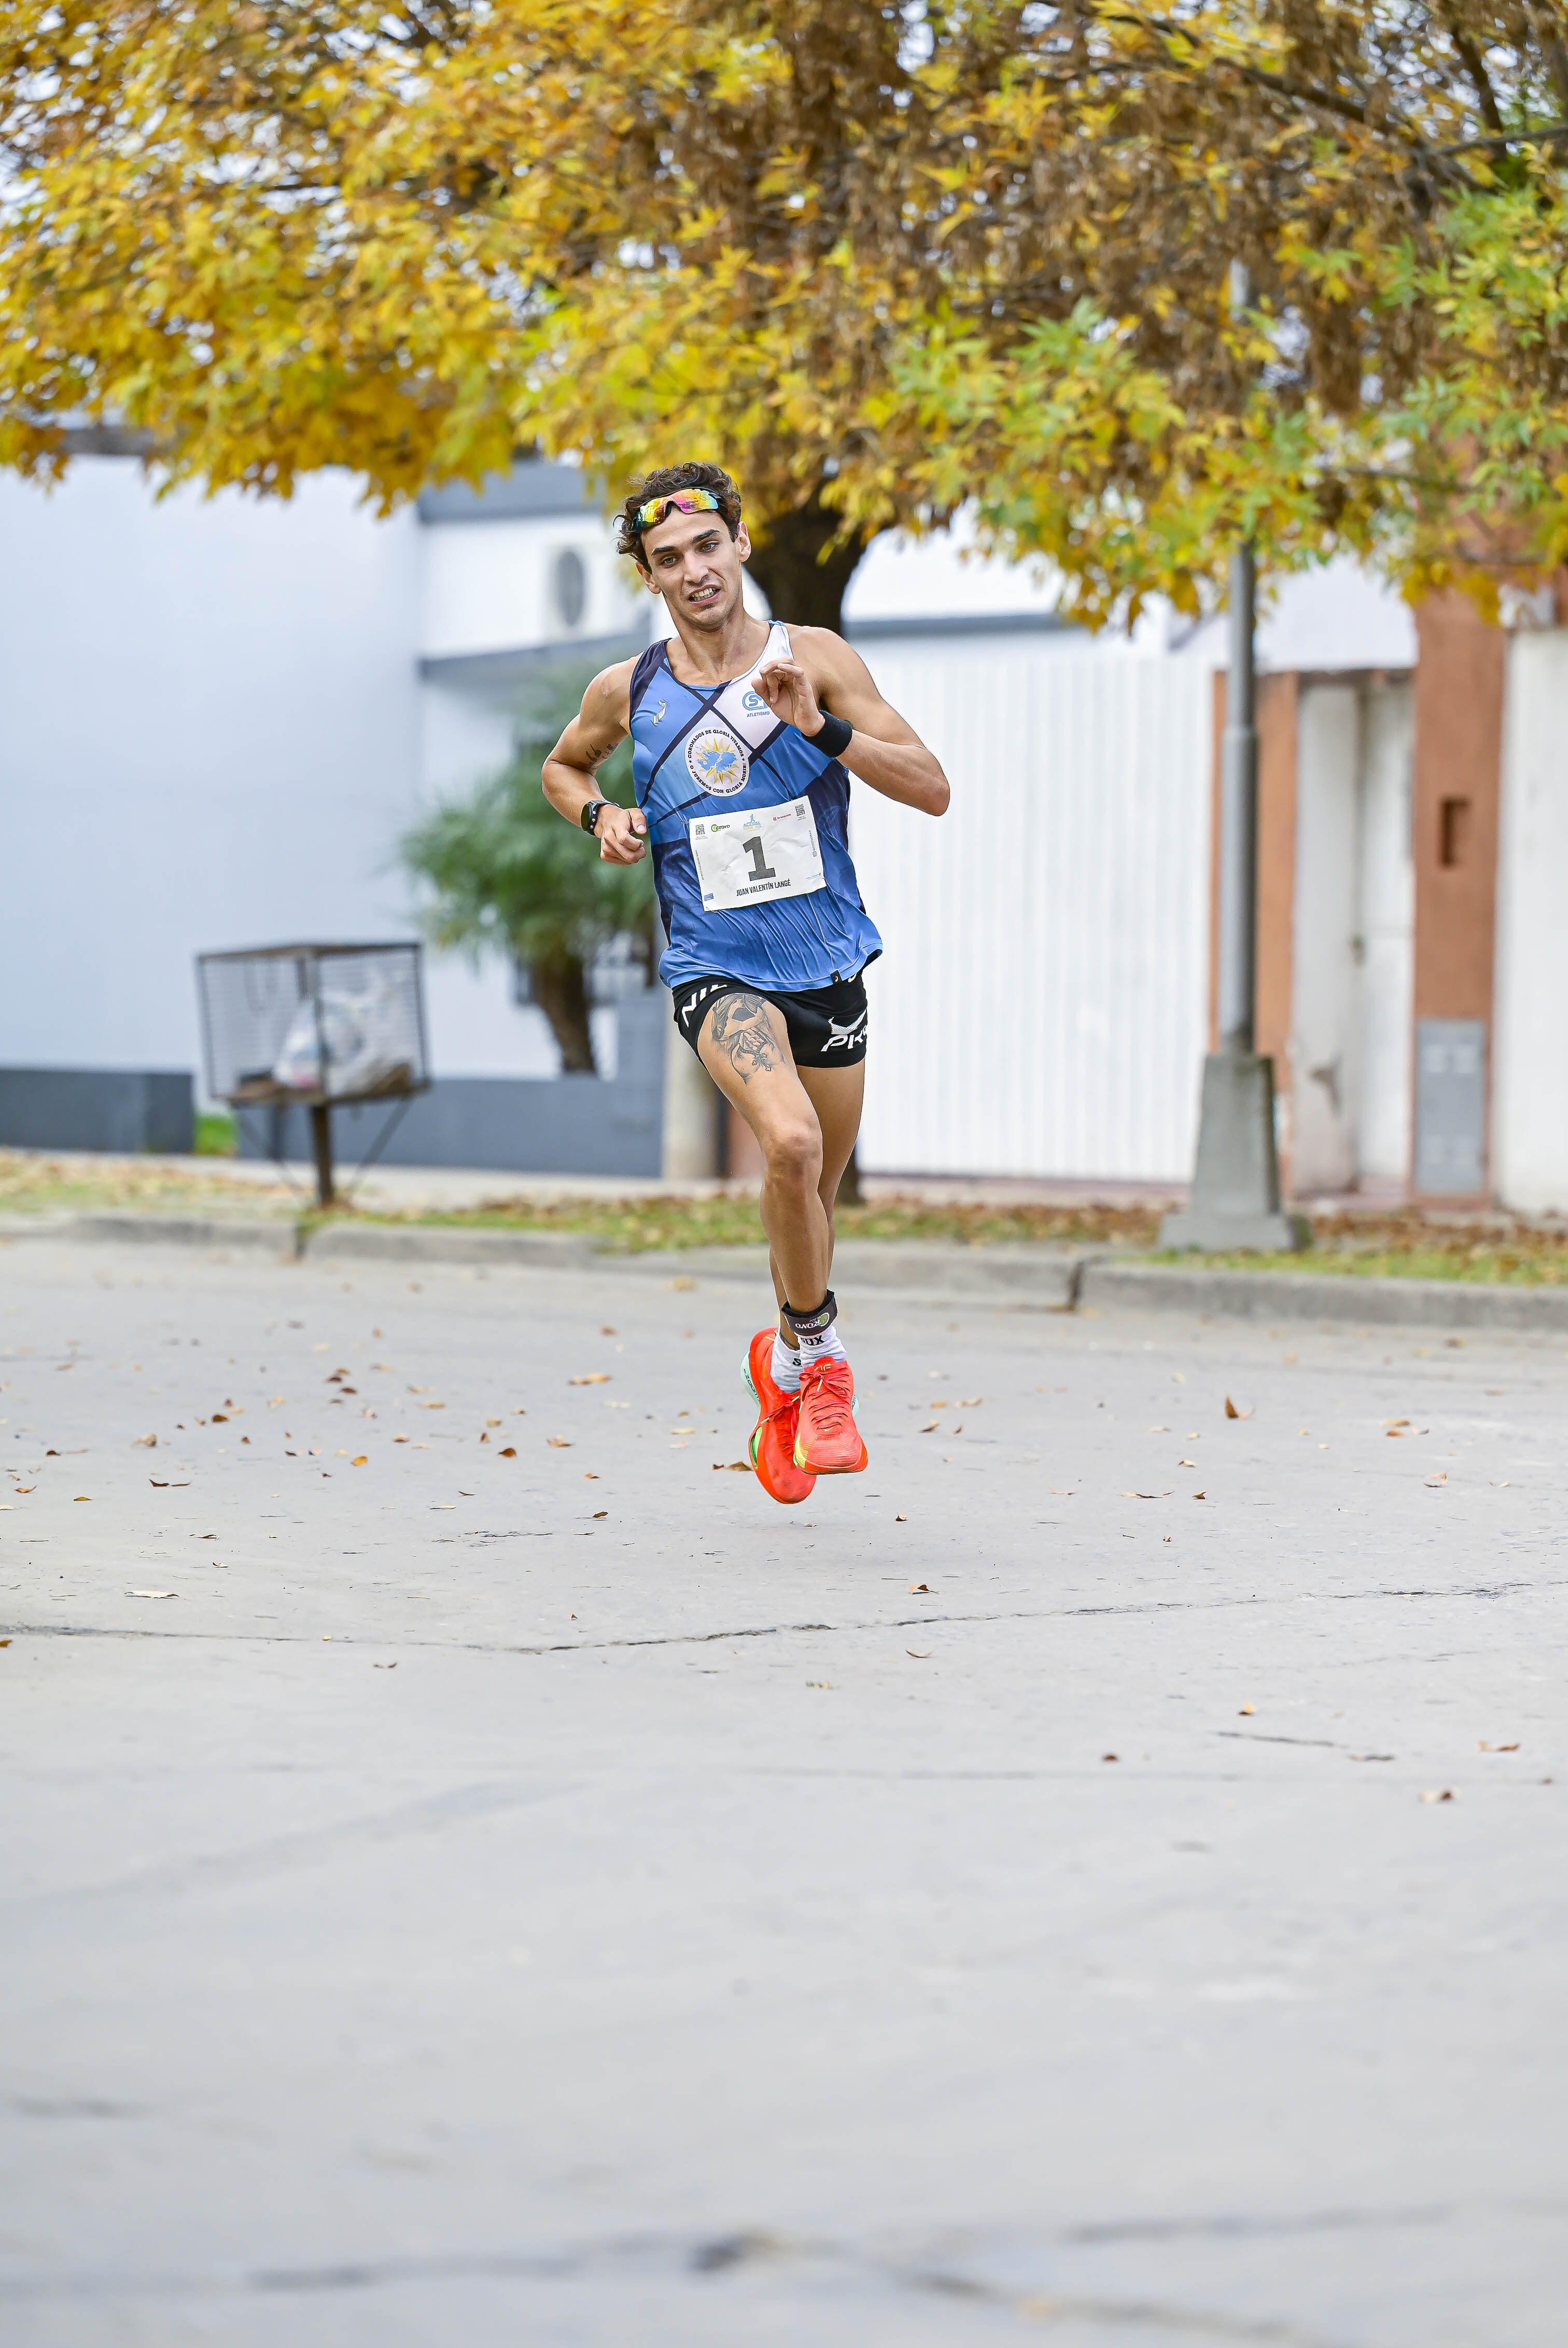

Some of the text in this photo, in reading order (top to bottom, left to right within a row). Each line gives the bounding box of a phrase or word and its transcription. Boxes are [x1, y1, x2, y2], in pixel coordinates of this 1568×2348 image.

[688, 732, 705, 758] CORONADOS
[713, 729, 730, 738] GLORIA
[730, 735, 744, 757] VIVAMOS
[692, 771, 712, 790] JUREMOS
[726, 781, 743, 793] GLORIA
[743, 836, 776, 882] 1
[736, 878, 791, 896] JUAN VALENTÍN LANGÉ
